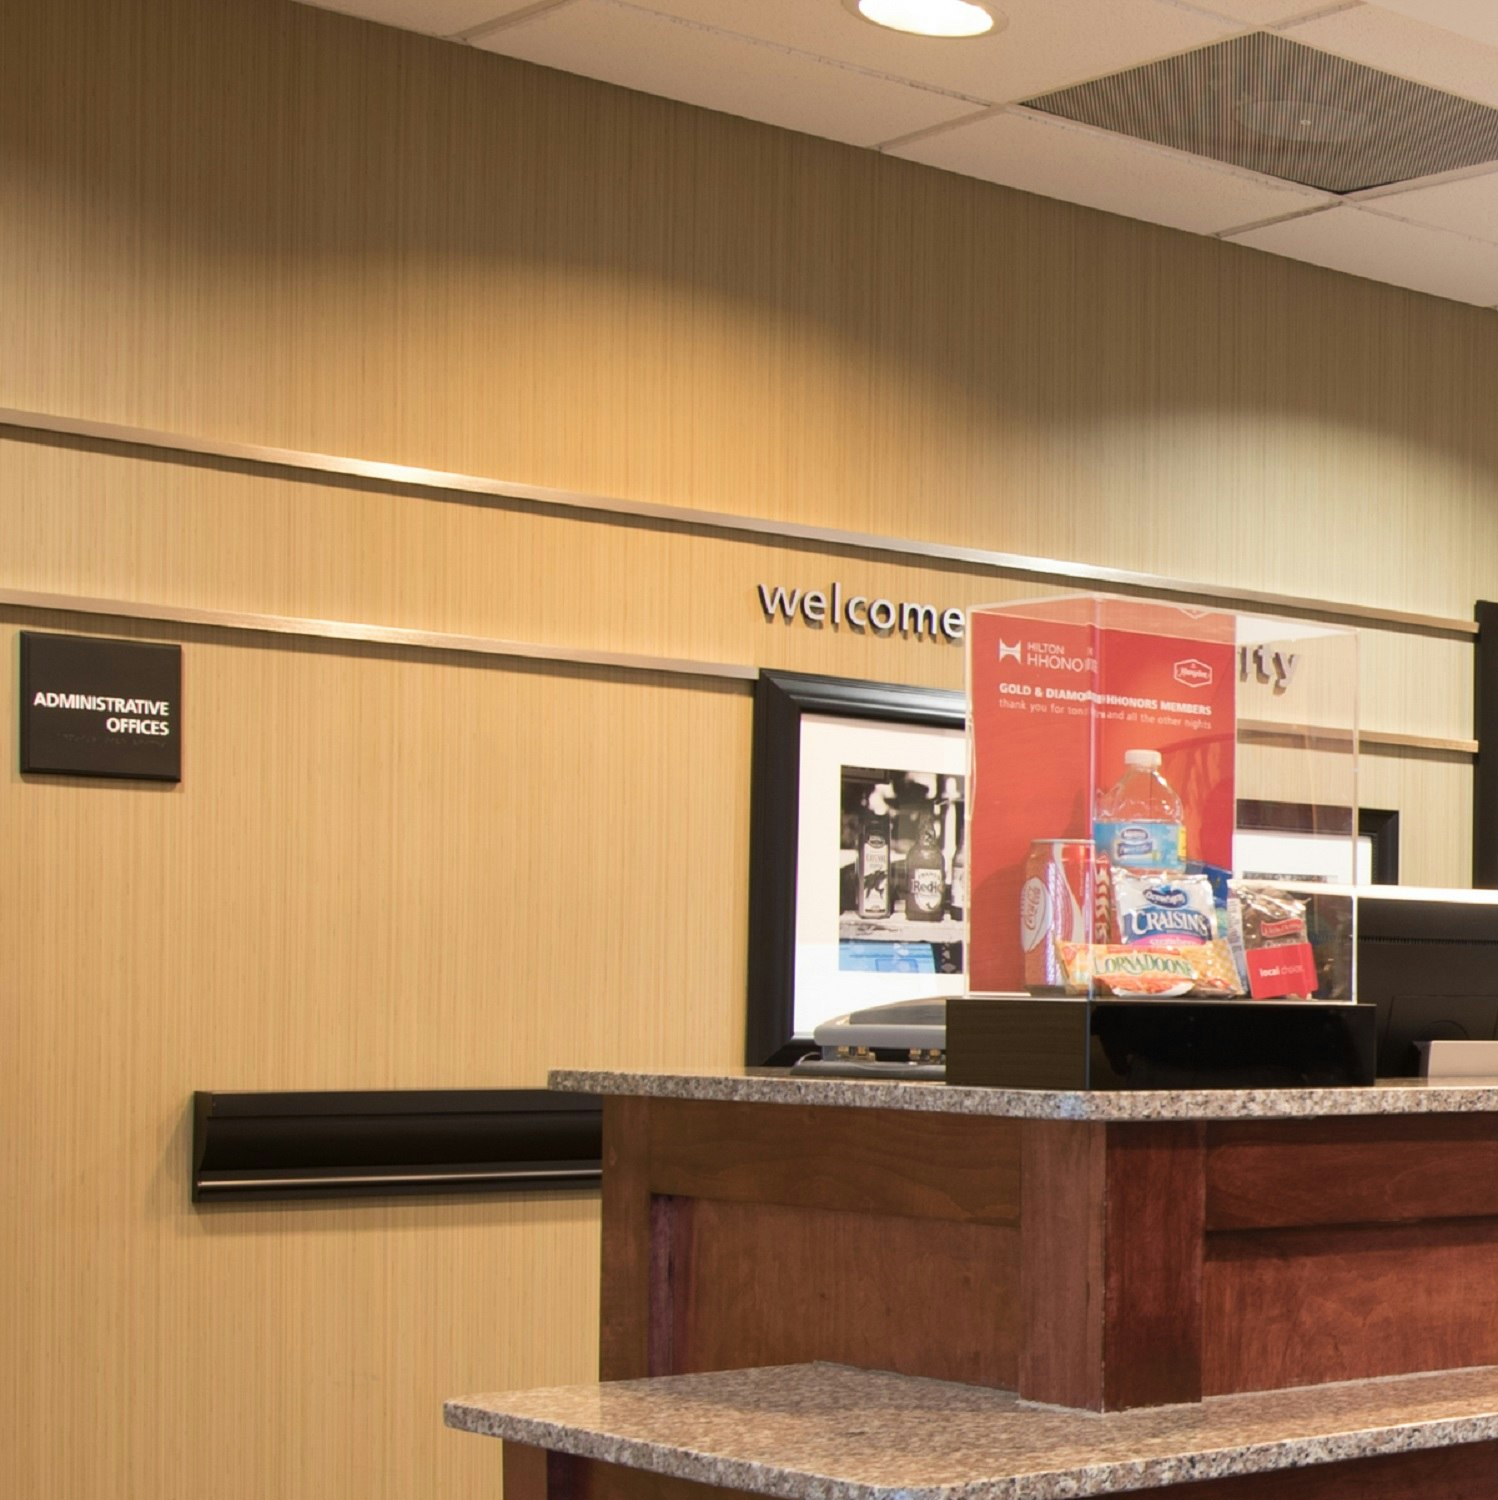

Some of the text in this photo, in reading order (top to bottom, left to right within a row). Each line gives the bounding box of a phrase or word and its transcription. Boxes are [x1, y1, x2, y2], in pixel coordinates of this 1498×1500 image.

[757, 581, 965, 639] welcome
[1027, 642, 1065, 655] HILTON
[1027, 652, 1097, 674] HHONO
[33, 691, 170, 717] ADMINISTRATIVE
[999, 682, 1032, 696] GOLD
[1034, 686, 1043, 698] &
[1107, 693, 1158, 711] HHONORS
[1160, 701, 1212, 716] MEMBERS
[106, 717, 170, 736] OFFICES
[999, 698, 1026, 710] thank
[1030, 703, 1047, 713] you
[1050, 702, 1065, 714] for
[1126, 711, 1137, 722] all
[1140, 713, 1156, 724] the
[1157, 714, 1182, 726] other
[1184, 715, 1212, 731] nights
